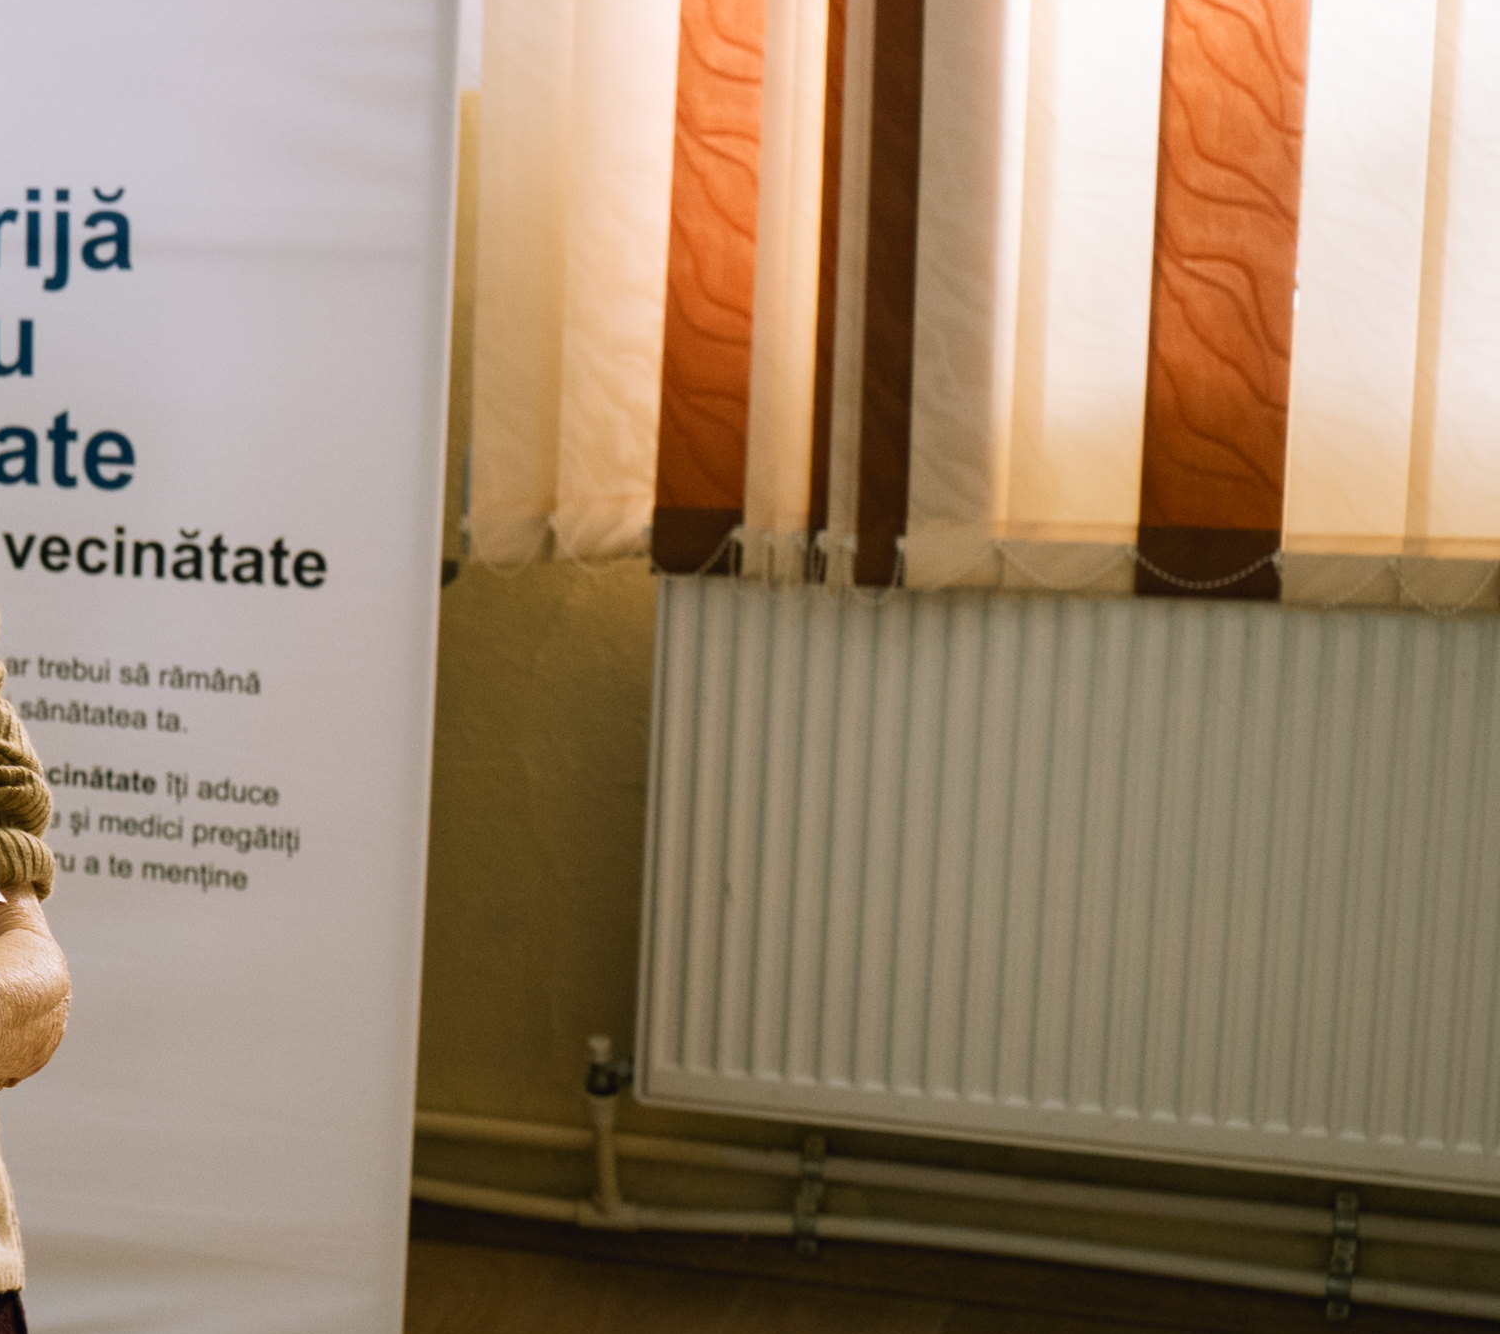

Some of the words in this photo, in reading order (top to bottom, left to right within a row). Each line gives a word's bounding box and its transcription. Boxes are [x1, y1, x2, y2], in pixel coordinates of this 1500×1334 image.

[3, 525, 328, 588] vecinătate
[38, 654, 111, 683] trebui
[119, 662, 149, 687] să
[158, 665, 260, 695] rămână
[19, 697, 148, 730] sănătatea
[156, 707, 188, 734] ta.
[48, 762, 157, 796] cinătate
[197, 776, 279, 807] aduce
[98, 812, 183, 841] medici
[83, 854, 100, 876] a
[108, 853, 133, 879] te
